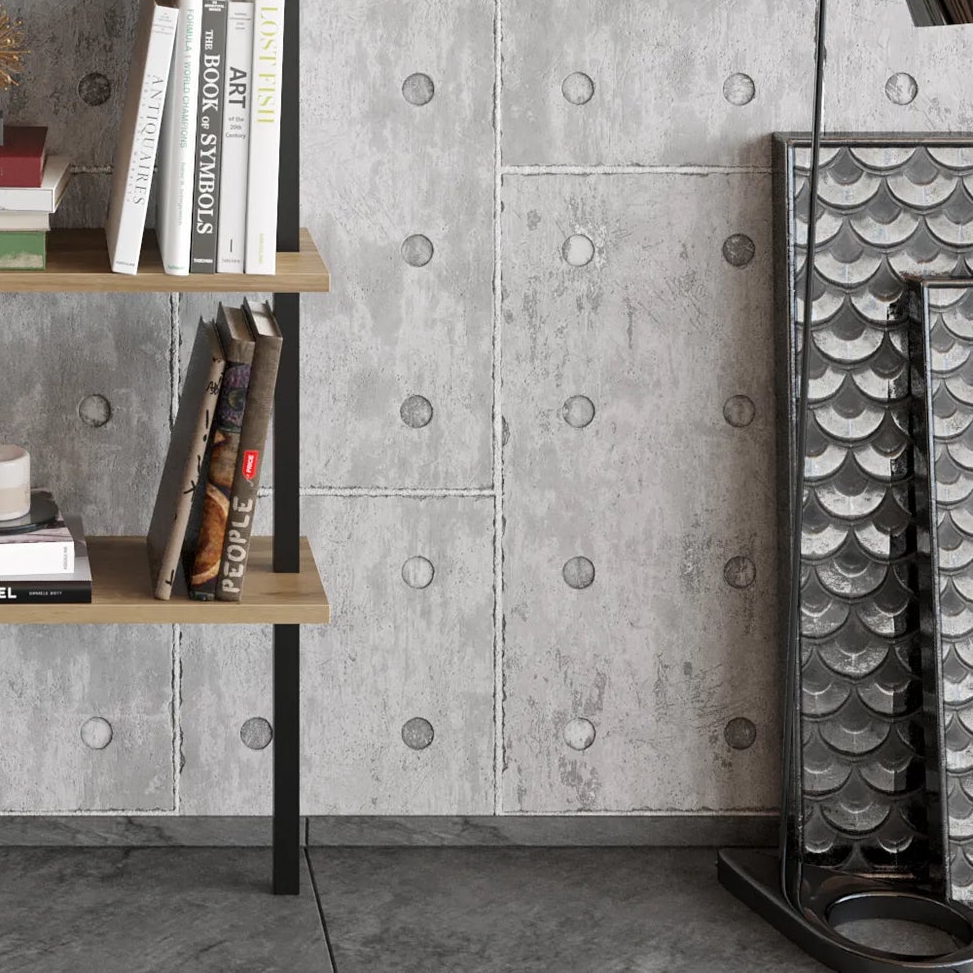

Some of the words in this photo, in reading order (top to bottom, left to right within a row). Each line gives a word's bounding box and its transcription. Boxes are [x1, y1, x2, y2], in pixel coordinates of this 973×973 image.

[184, 9, 195, 52] FORMULA
[204, 30, 214, 50] THE
[258, 6, 278, 66] LOST
[182, 61, 192, 94] WORLD
[201, 54, 221, 112] BOOK
[228, 66, 248, 109] ART
[257, 72, 276, 124] FISH
[133, 74, 165, 206] ANTIQUAIRES
[179, 95, 191, 149] CHAMPIONS
[201, 116, 210, 130] OF
[225, 132, 247, 140] Century
[196, 134, 218, 235] SYMBOLS
[222, 495, 253, 593] PEOPLE
